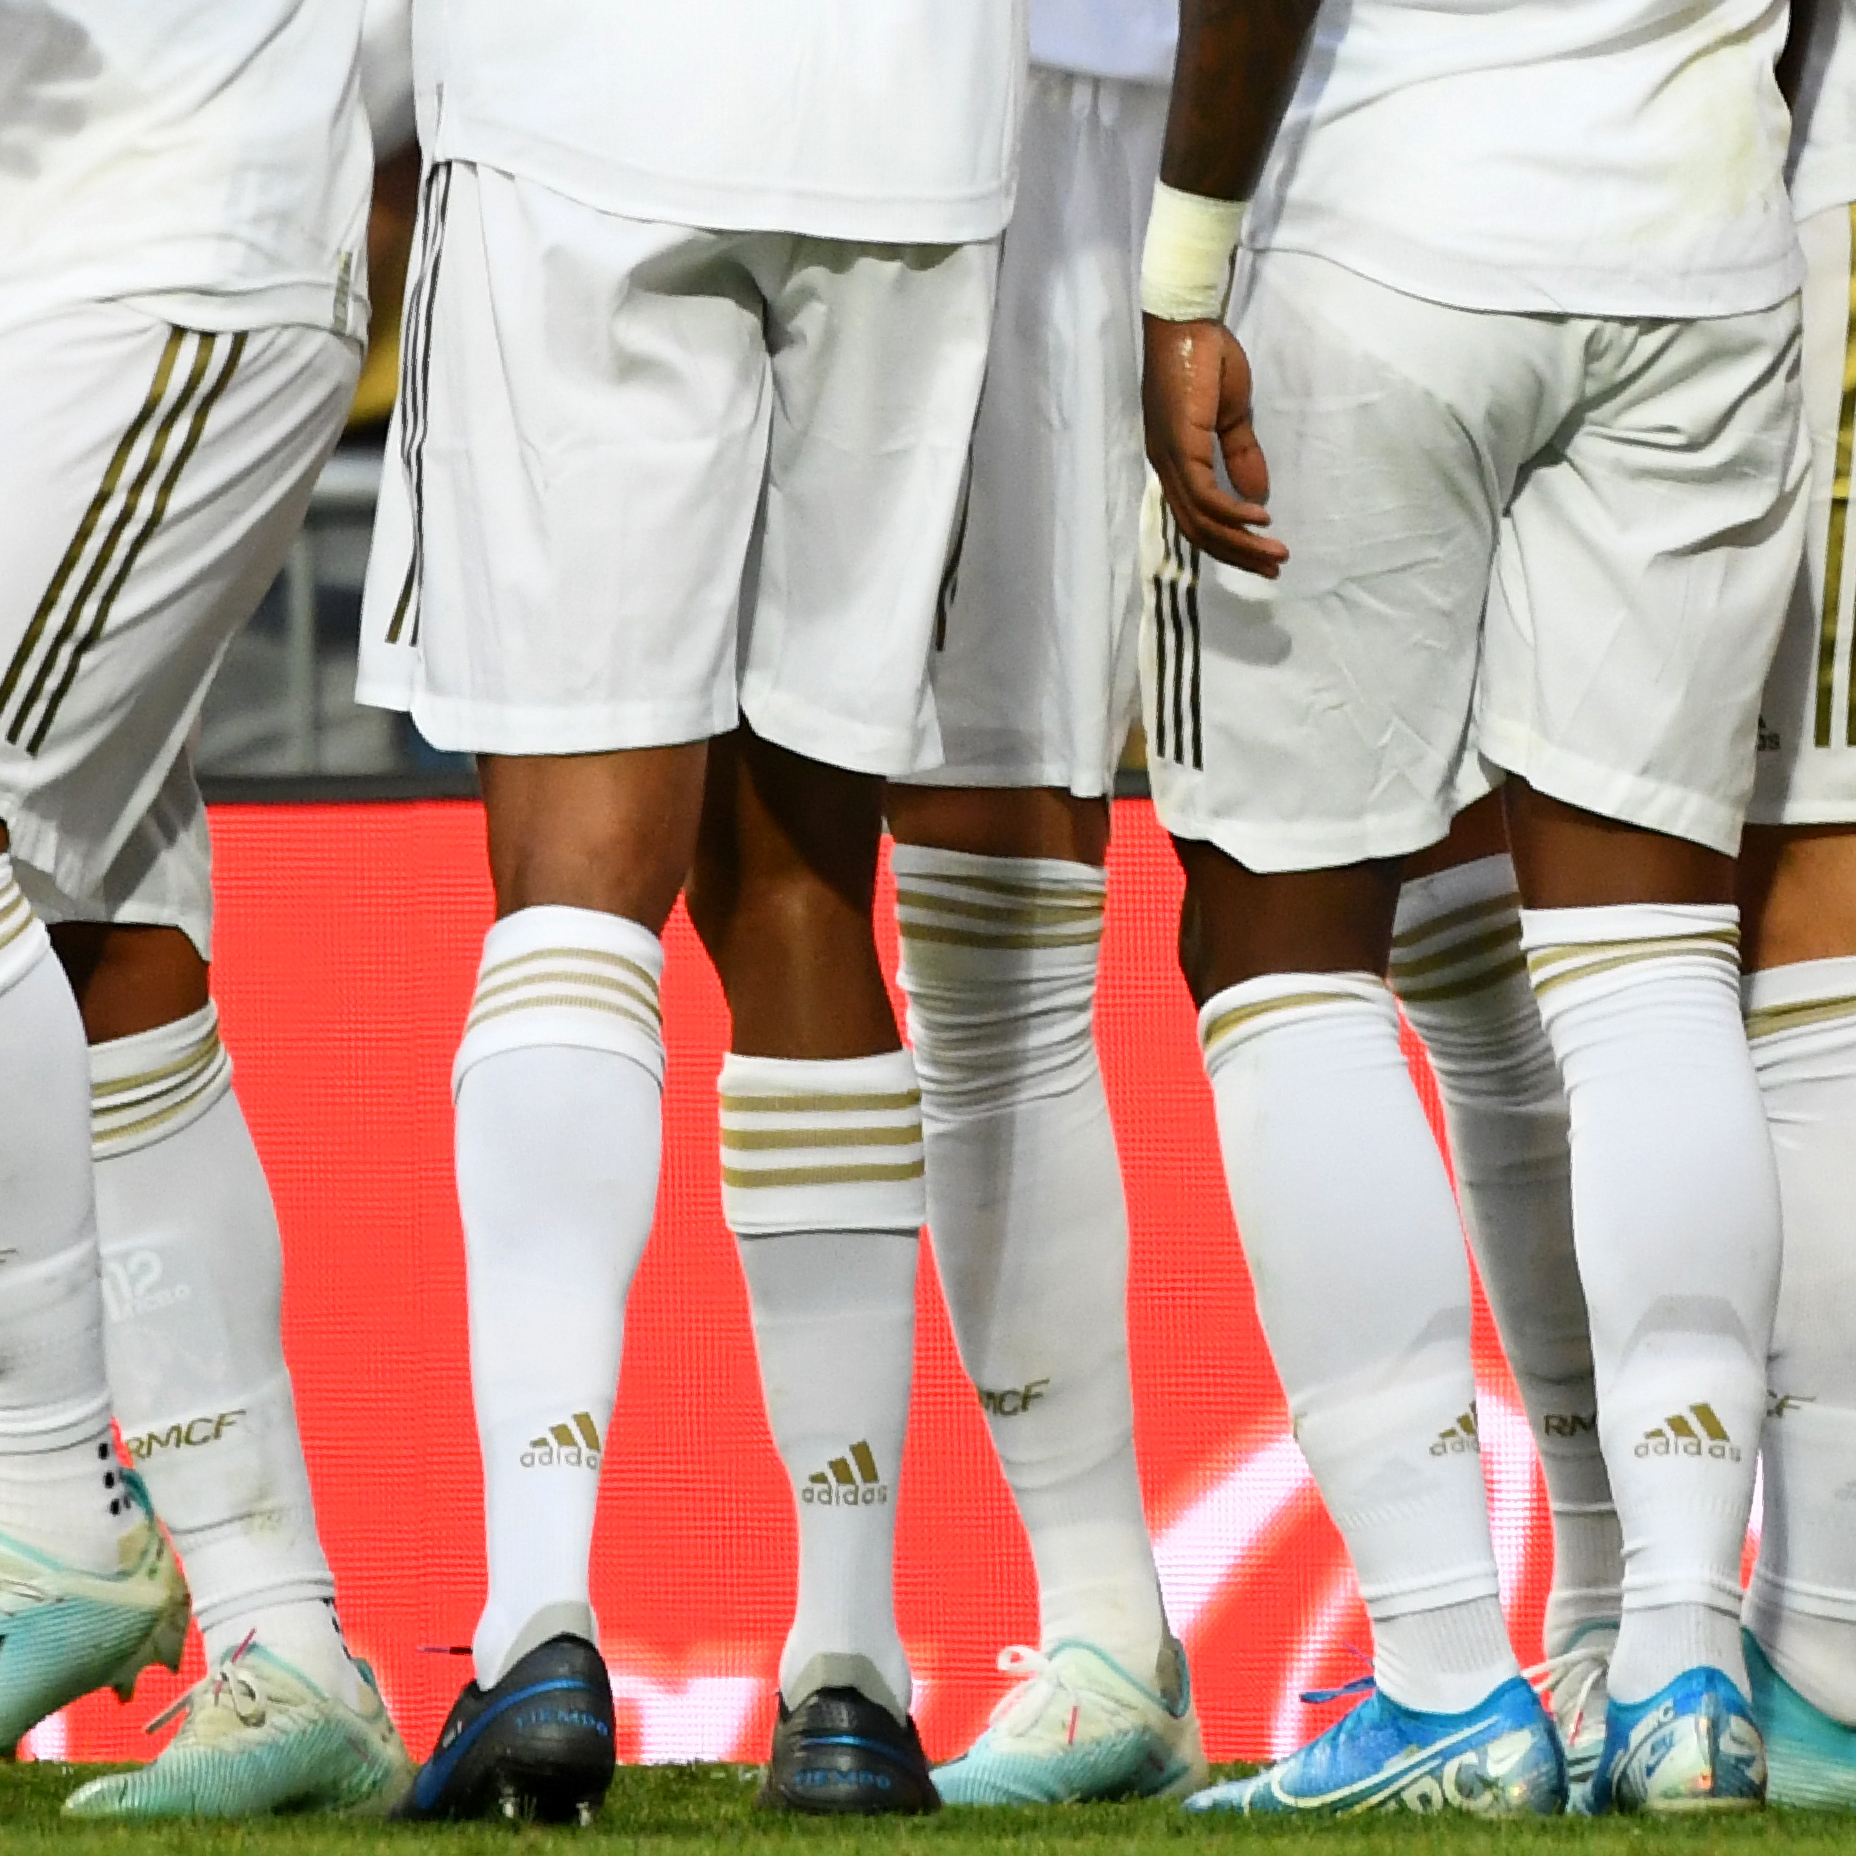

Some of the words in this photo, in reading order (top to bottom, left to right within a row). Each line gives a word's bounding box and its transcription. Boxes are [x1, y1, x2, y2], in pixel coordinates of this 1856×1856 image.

[124, 1409, 247, 1458] RMCF
[1634, 1432, 1744, 1462] adidas
[520, 1445, 600, 1469] adida
[801, 1484, 889, 1506] adidas
